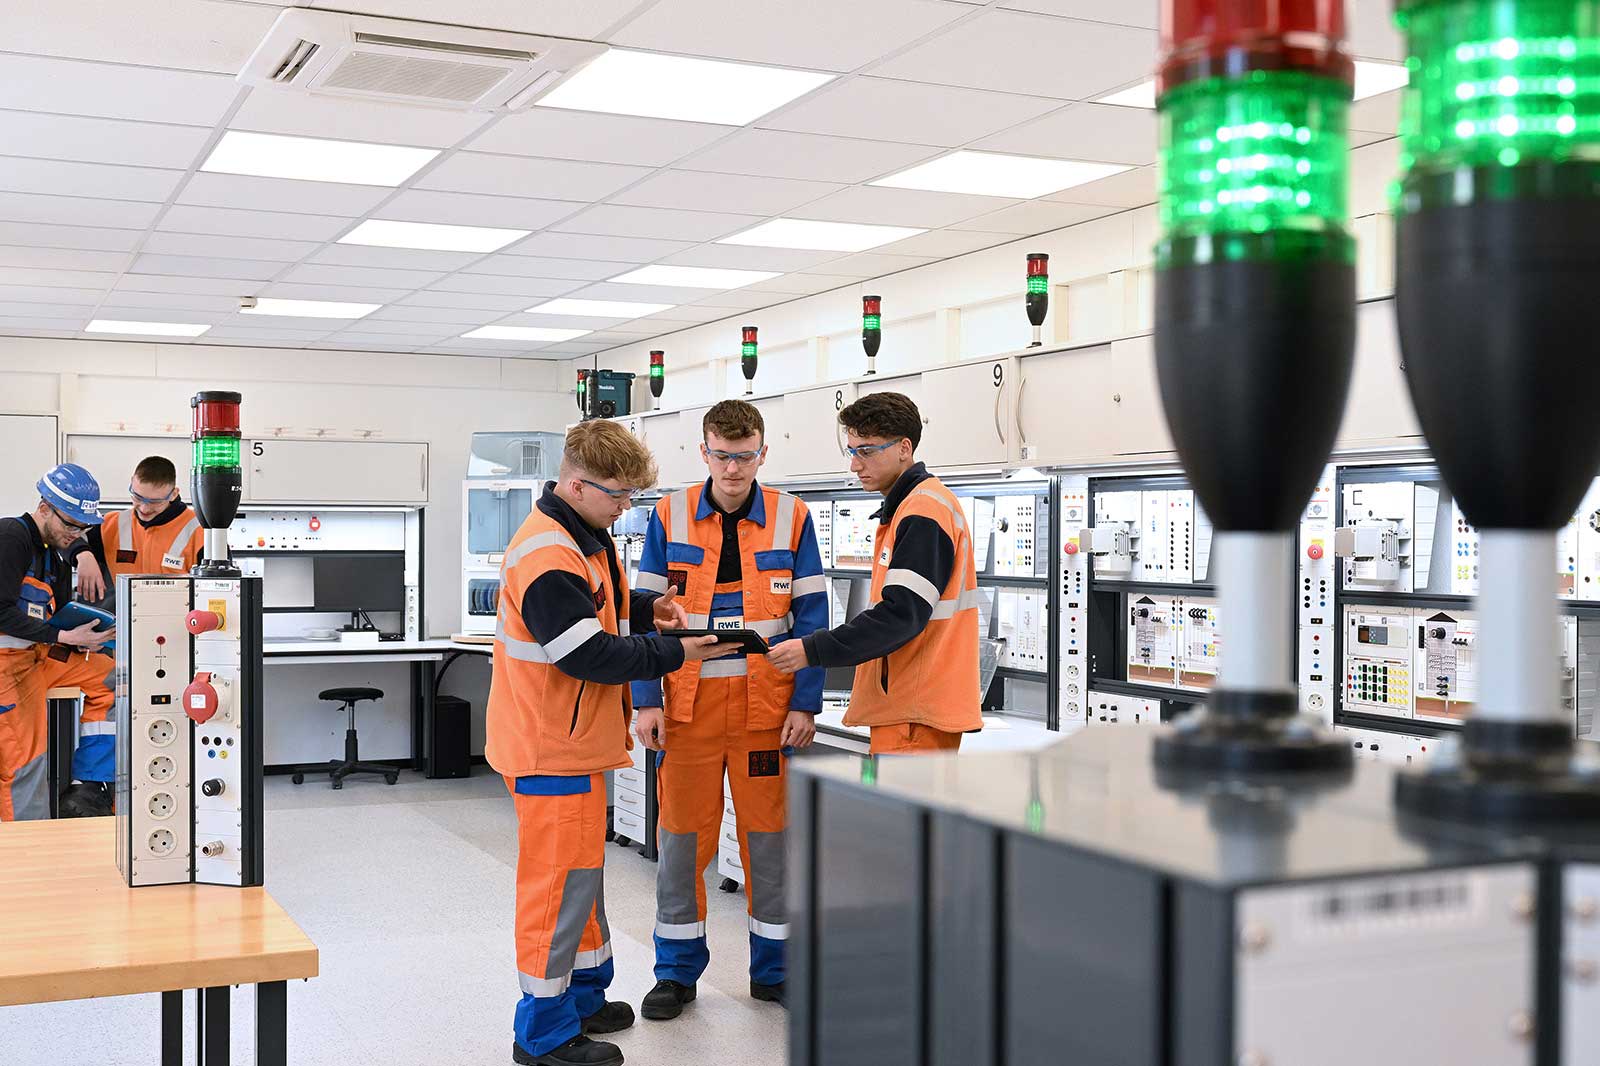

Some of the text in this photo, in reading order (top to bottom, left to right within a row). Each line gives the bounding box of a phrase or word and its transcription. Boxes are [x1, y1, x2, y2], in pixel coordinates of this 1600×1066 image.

[993, 363, 1003, 387] 9
[835, 390, 843, 411] 8
[252, 442, 264, 456] 5
[164, 557, 182, 566] RWE
[773, 582, 790, 590] RWE
[718, 621, 741, 629] RWE
